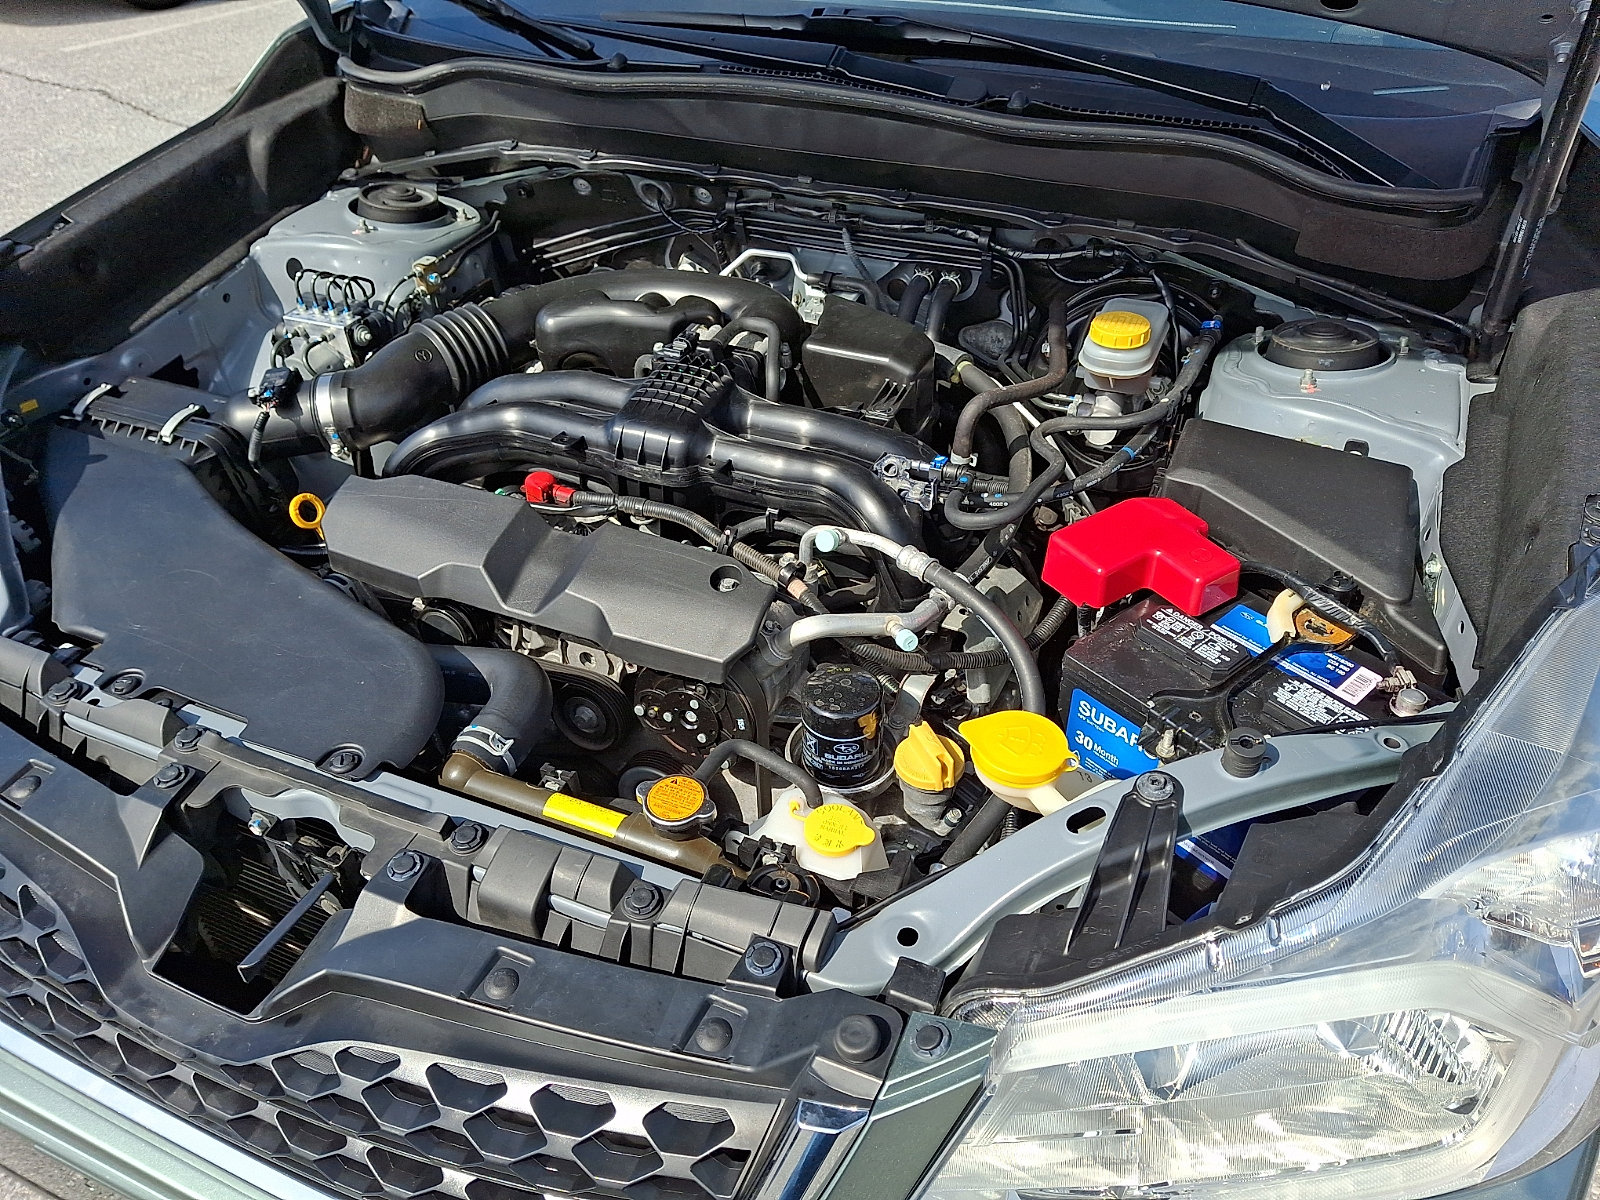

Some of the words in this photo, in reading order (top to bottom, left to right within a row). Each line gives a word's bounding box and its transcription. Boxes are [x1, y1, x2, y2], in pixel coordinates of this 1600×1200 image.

[1172, 611, 1204, 630] DANGER
[1208, 631, 1238, 649] POISON
[1075, 730, 1094, 751] 30
[1093, 742, 1120, 765] Month
[1078, 700, 1157, 760] SUBAR
[824, 750, 868, 760] SUBARU
